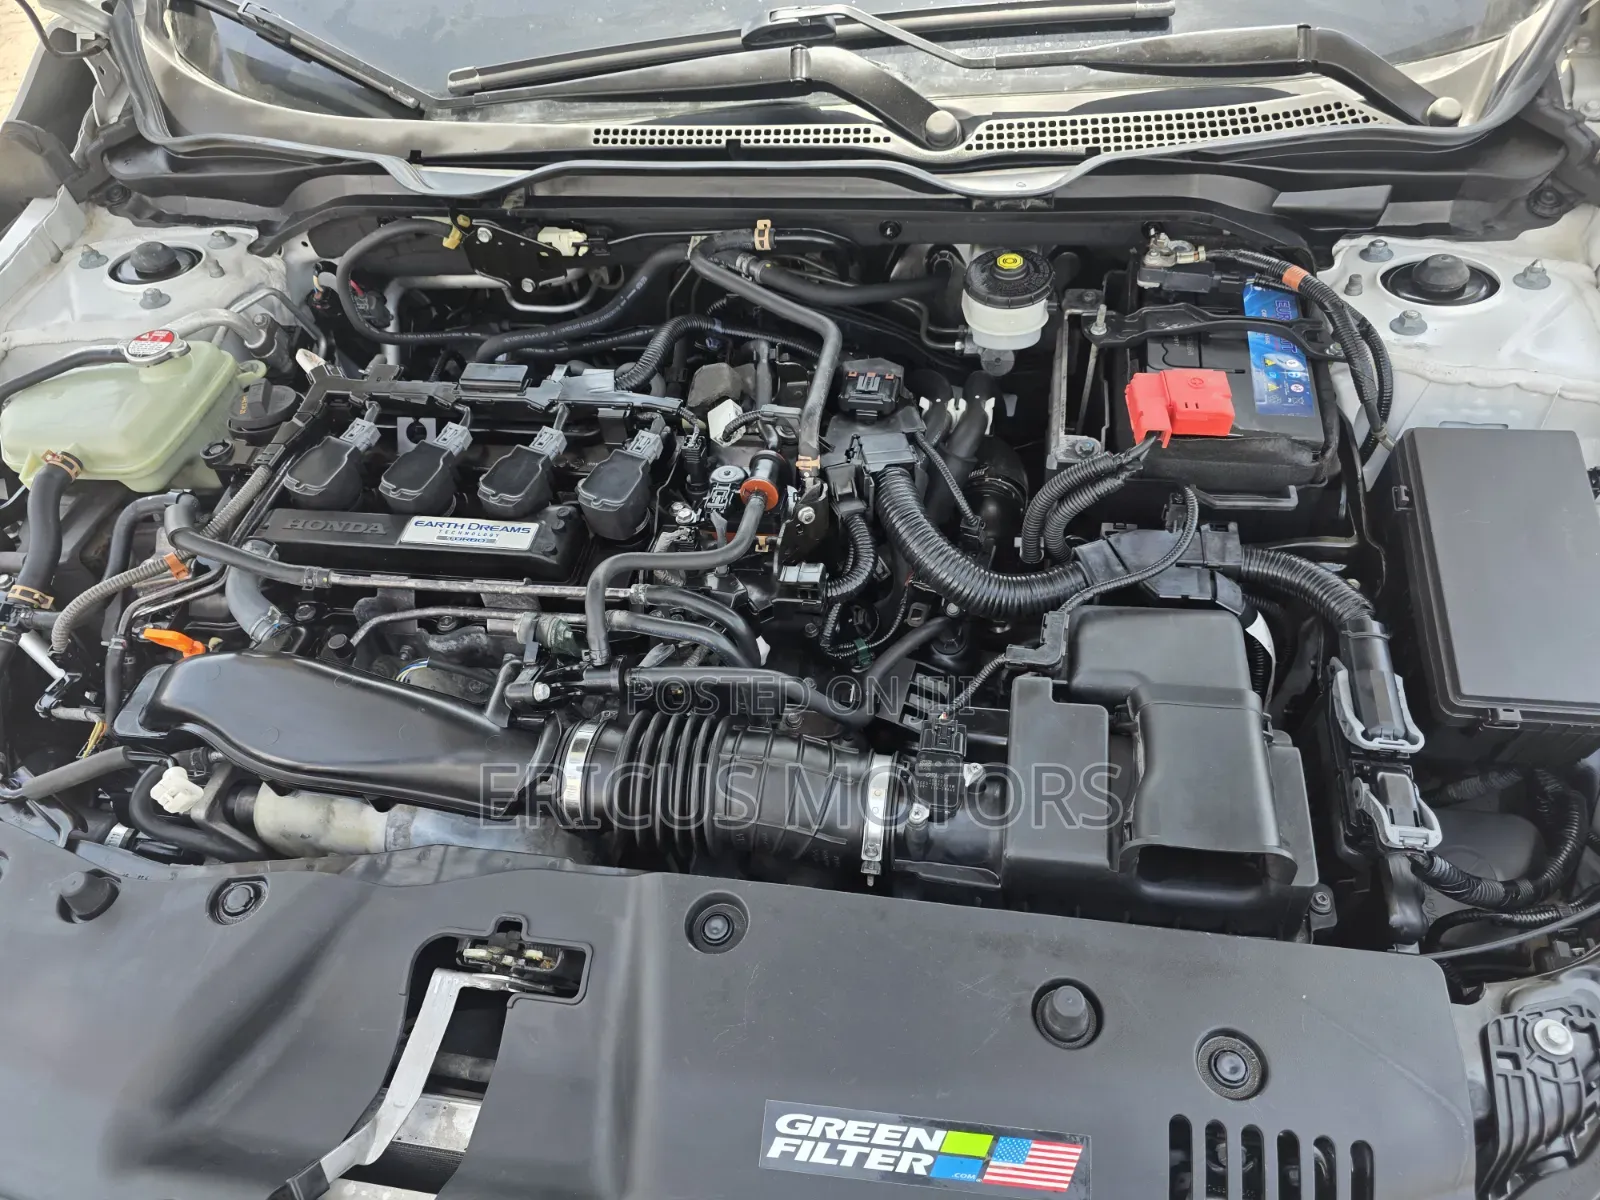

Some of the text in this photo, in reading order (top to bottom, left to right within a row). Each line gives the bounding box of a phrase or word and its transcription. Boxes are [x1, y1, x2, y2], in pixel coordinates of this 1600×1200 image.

[284, 518, 388, 535] HONDA
[414, 519, 531, 534] EARTH DREAMS
[439, 529, 499, 538] TECHNOLOGY
[775, 1112, 948, 1153] GREEN
[766, 1136, 977, 1181] FILTER .COM
